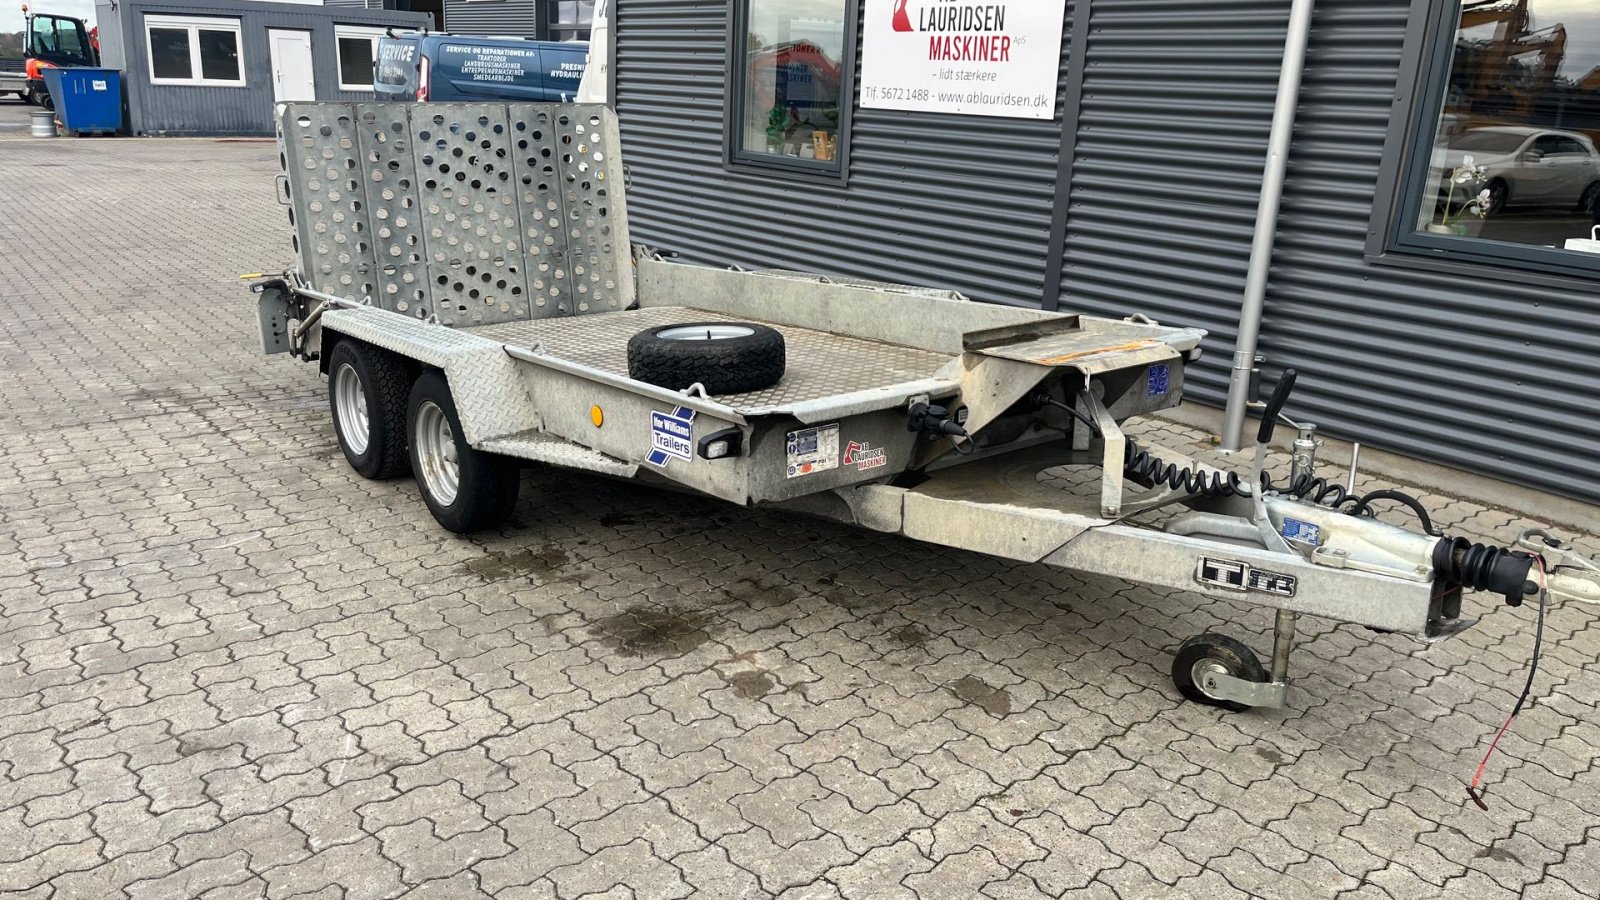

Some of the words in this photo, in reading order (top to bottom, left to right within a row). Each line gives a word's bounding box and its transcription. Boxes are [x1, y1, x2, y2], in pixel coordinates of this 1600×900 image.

[919, 5, 1006, 32] LAURIDSEN
[382, 44, 415, 62] SERVICE
[446, 46, 471, 54] SERVICE
[482, 48, 525, 57] REPARATIONER
[929, 35, 1011, 62] MASKINER
[464, 60, 521, 69] LANDBRUGSMASKINER
[560, 63, 585, 71] PRESNI
[473, 74, 514, 82] SMEDEARBEJDE
[550, 70, 582, 79] HYDRAULI
[939, 68, 953, 81] lidt
[955, 69, 997, 82] stærkere
[881, 87, 904, 101] 5672
[906, 88, 929, 101] 1488
[938, 91, 1048, 108] www.ablauridsen.dk
[664, 419, 690, 437] Williams
[654, 432, 690, 454] Trailers
[858, 456, 887, 470] MASKINER
